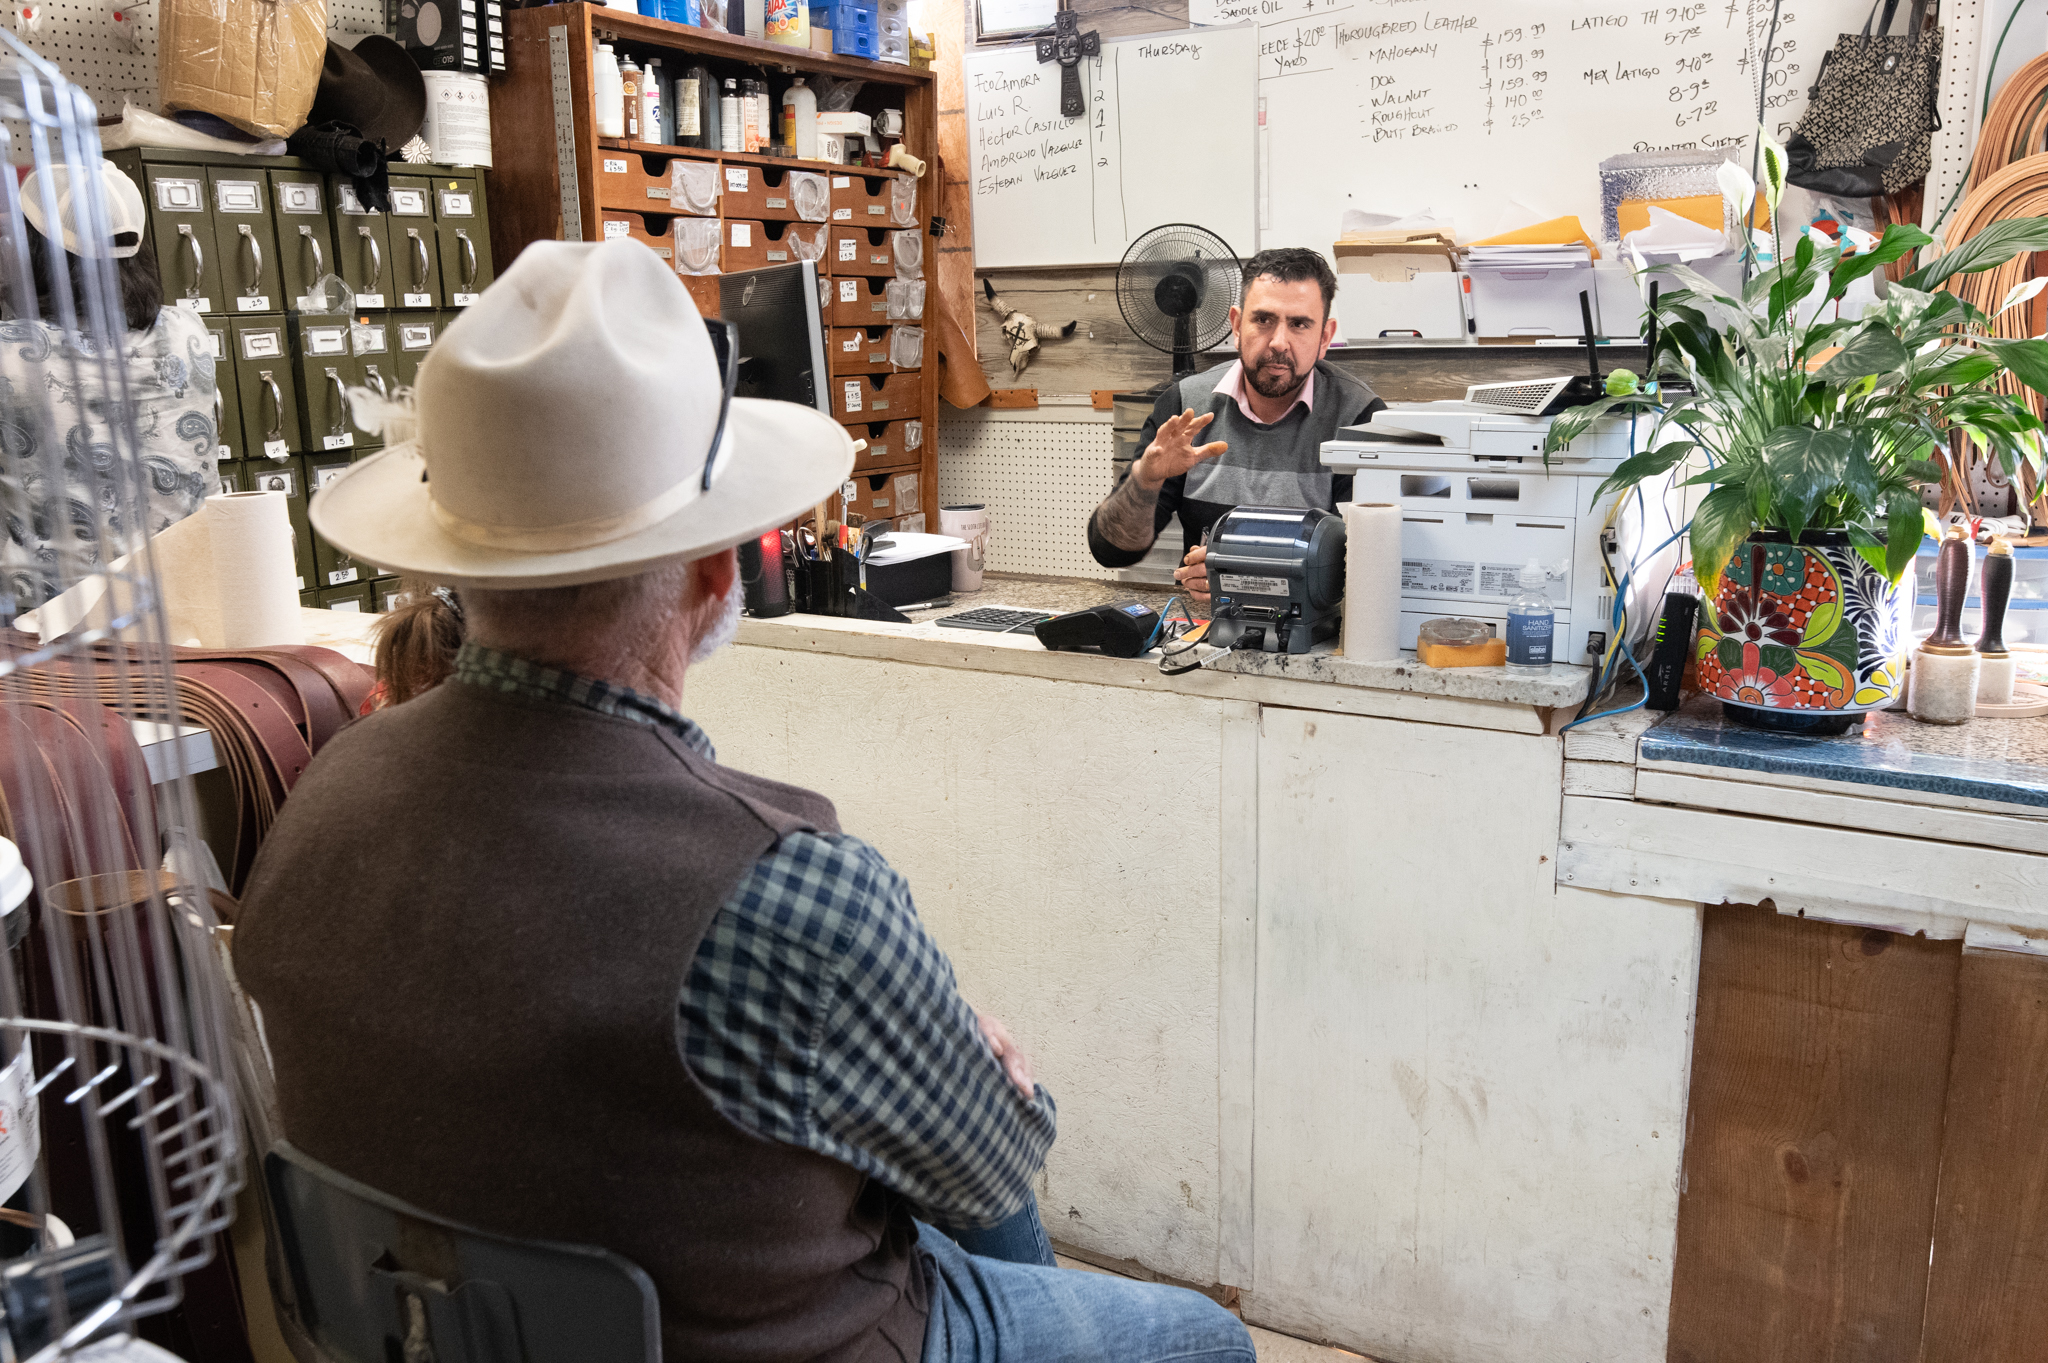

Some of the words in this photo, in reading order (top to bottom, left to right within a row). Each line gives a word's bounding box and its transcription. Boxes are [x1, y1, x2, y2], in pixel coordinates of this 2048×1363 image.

[1261, 1, 1284, 15] OIL
[1424, 11, 1479, 31] LEATHER
[1571, 14, 1629, 31] LATIGO
[1258, 38, 1289, 57] EECE
[1369, 43, 1438, 64] MAHOGANY
[1274, 55, 1308, 76] YARD
[1615, 60, 1661, 81] LATIGO
[1093, 89, 1106, 102] 2
[1371, 88, 1432, 108] WALNUT
[1096, 157, 1109, 167] 2
[1662, 664, 1672, 693] ARRIS
